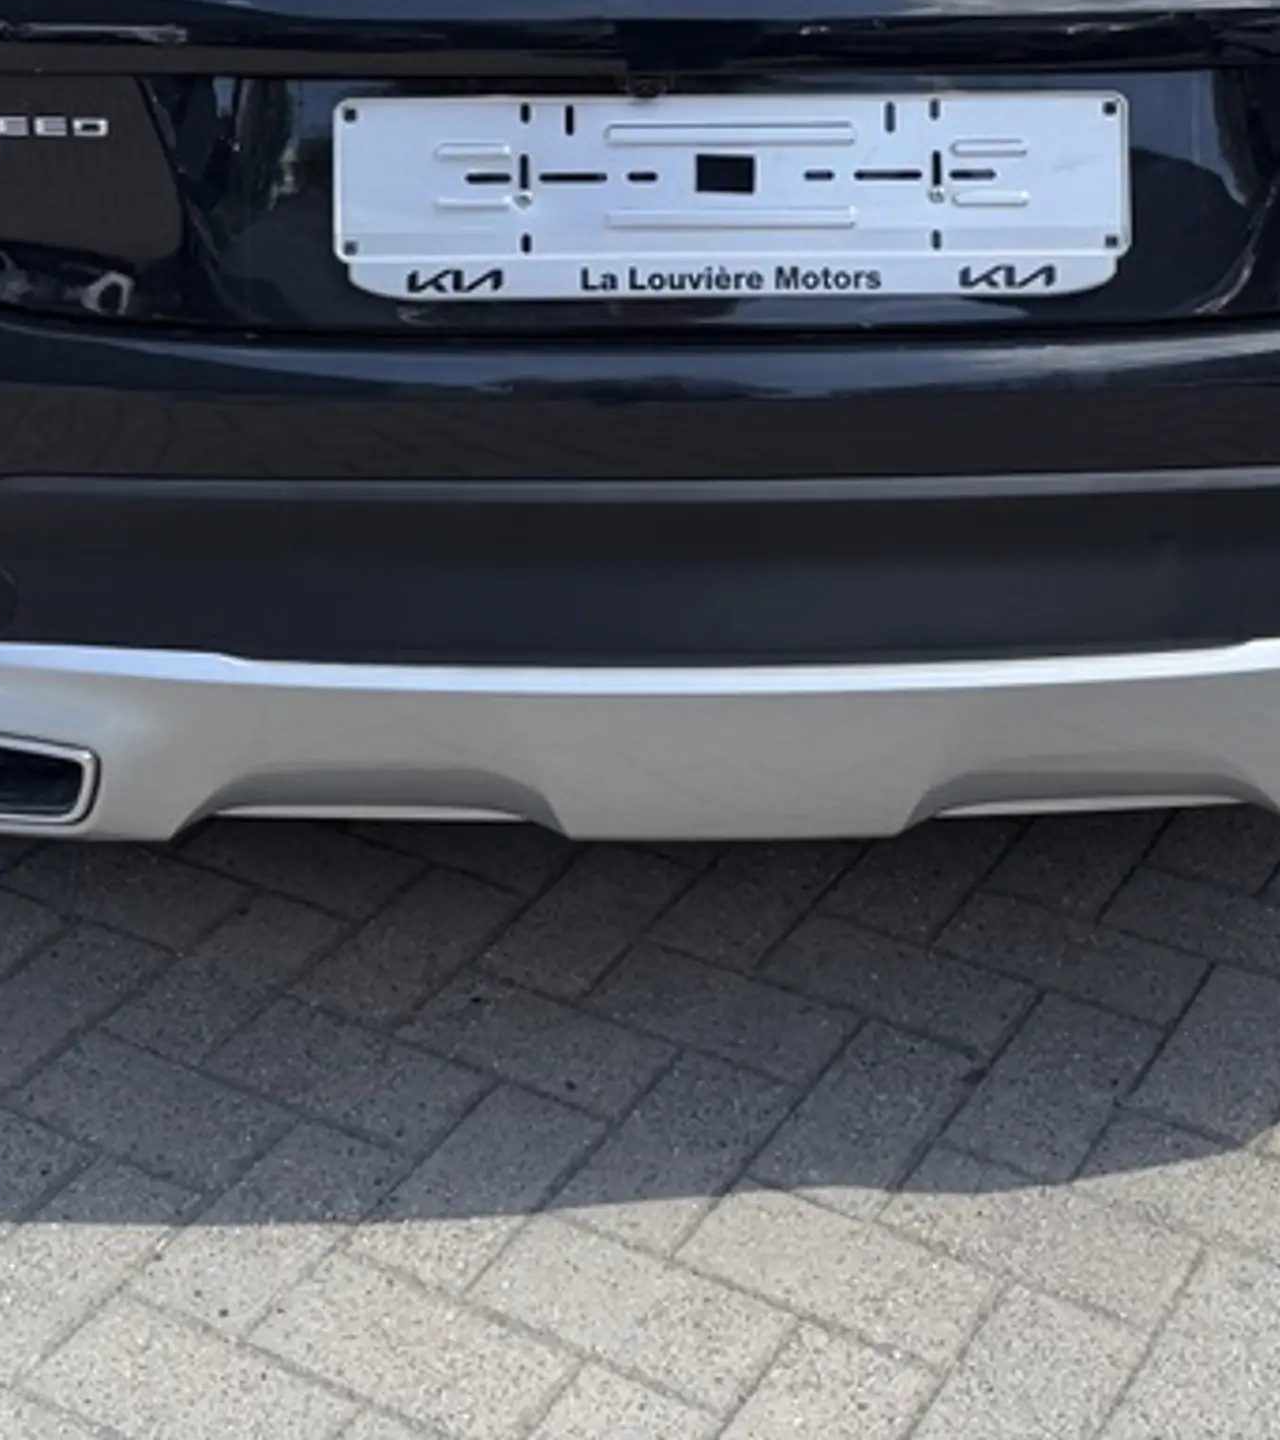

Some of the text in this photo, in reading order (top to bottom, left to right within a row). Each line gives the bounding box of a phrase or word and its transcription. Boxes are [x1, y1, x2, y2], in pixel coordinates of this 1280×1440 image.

[406, 263, 1058, 294] KIA La Louvière Motors KIA
